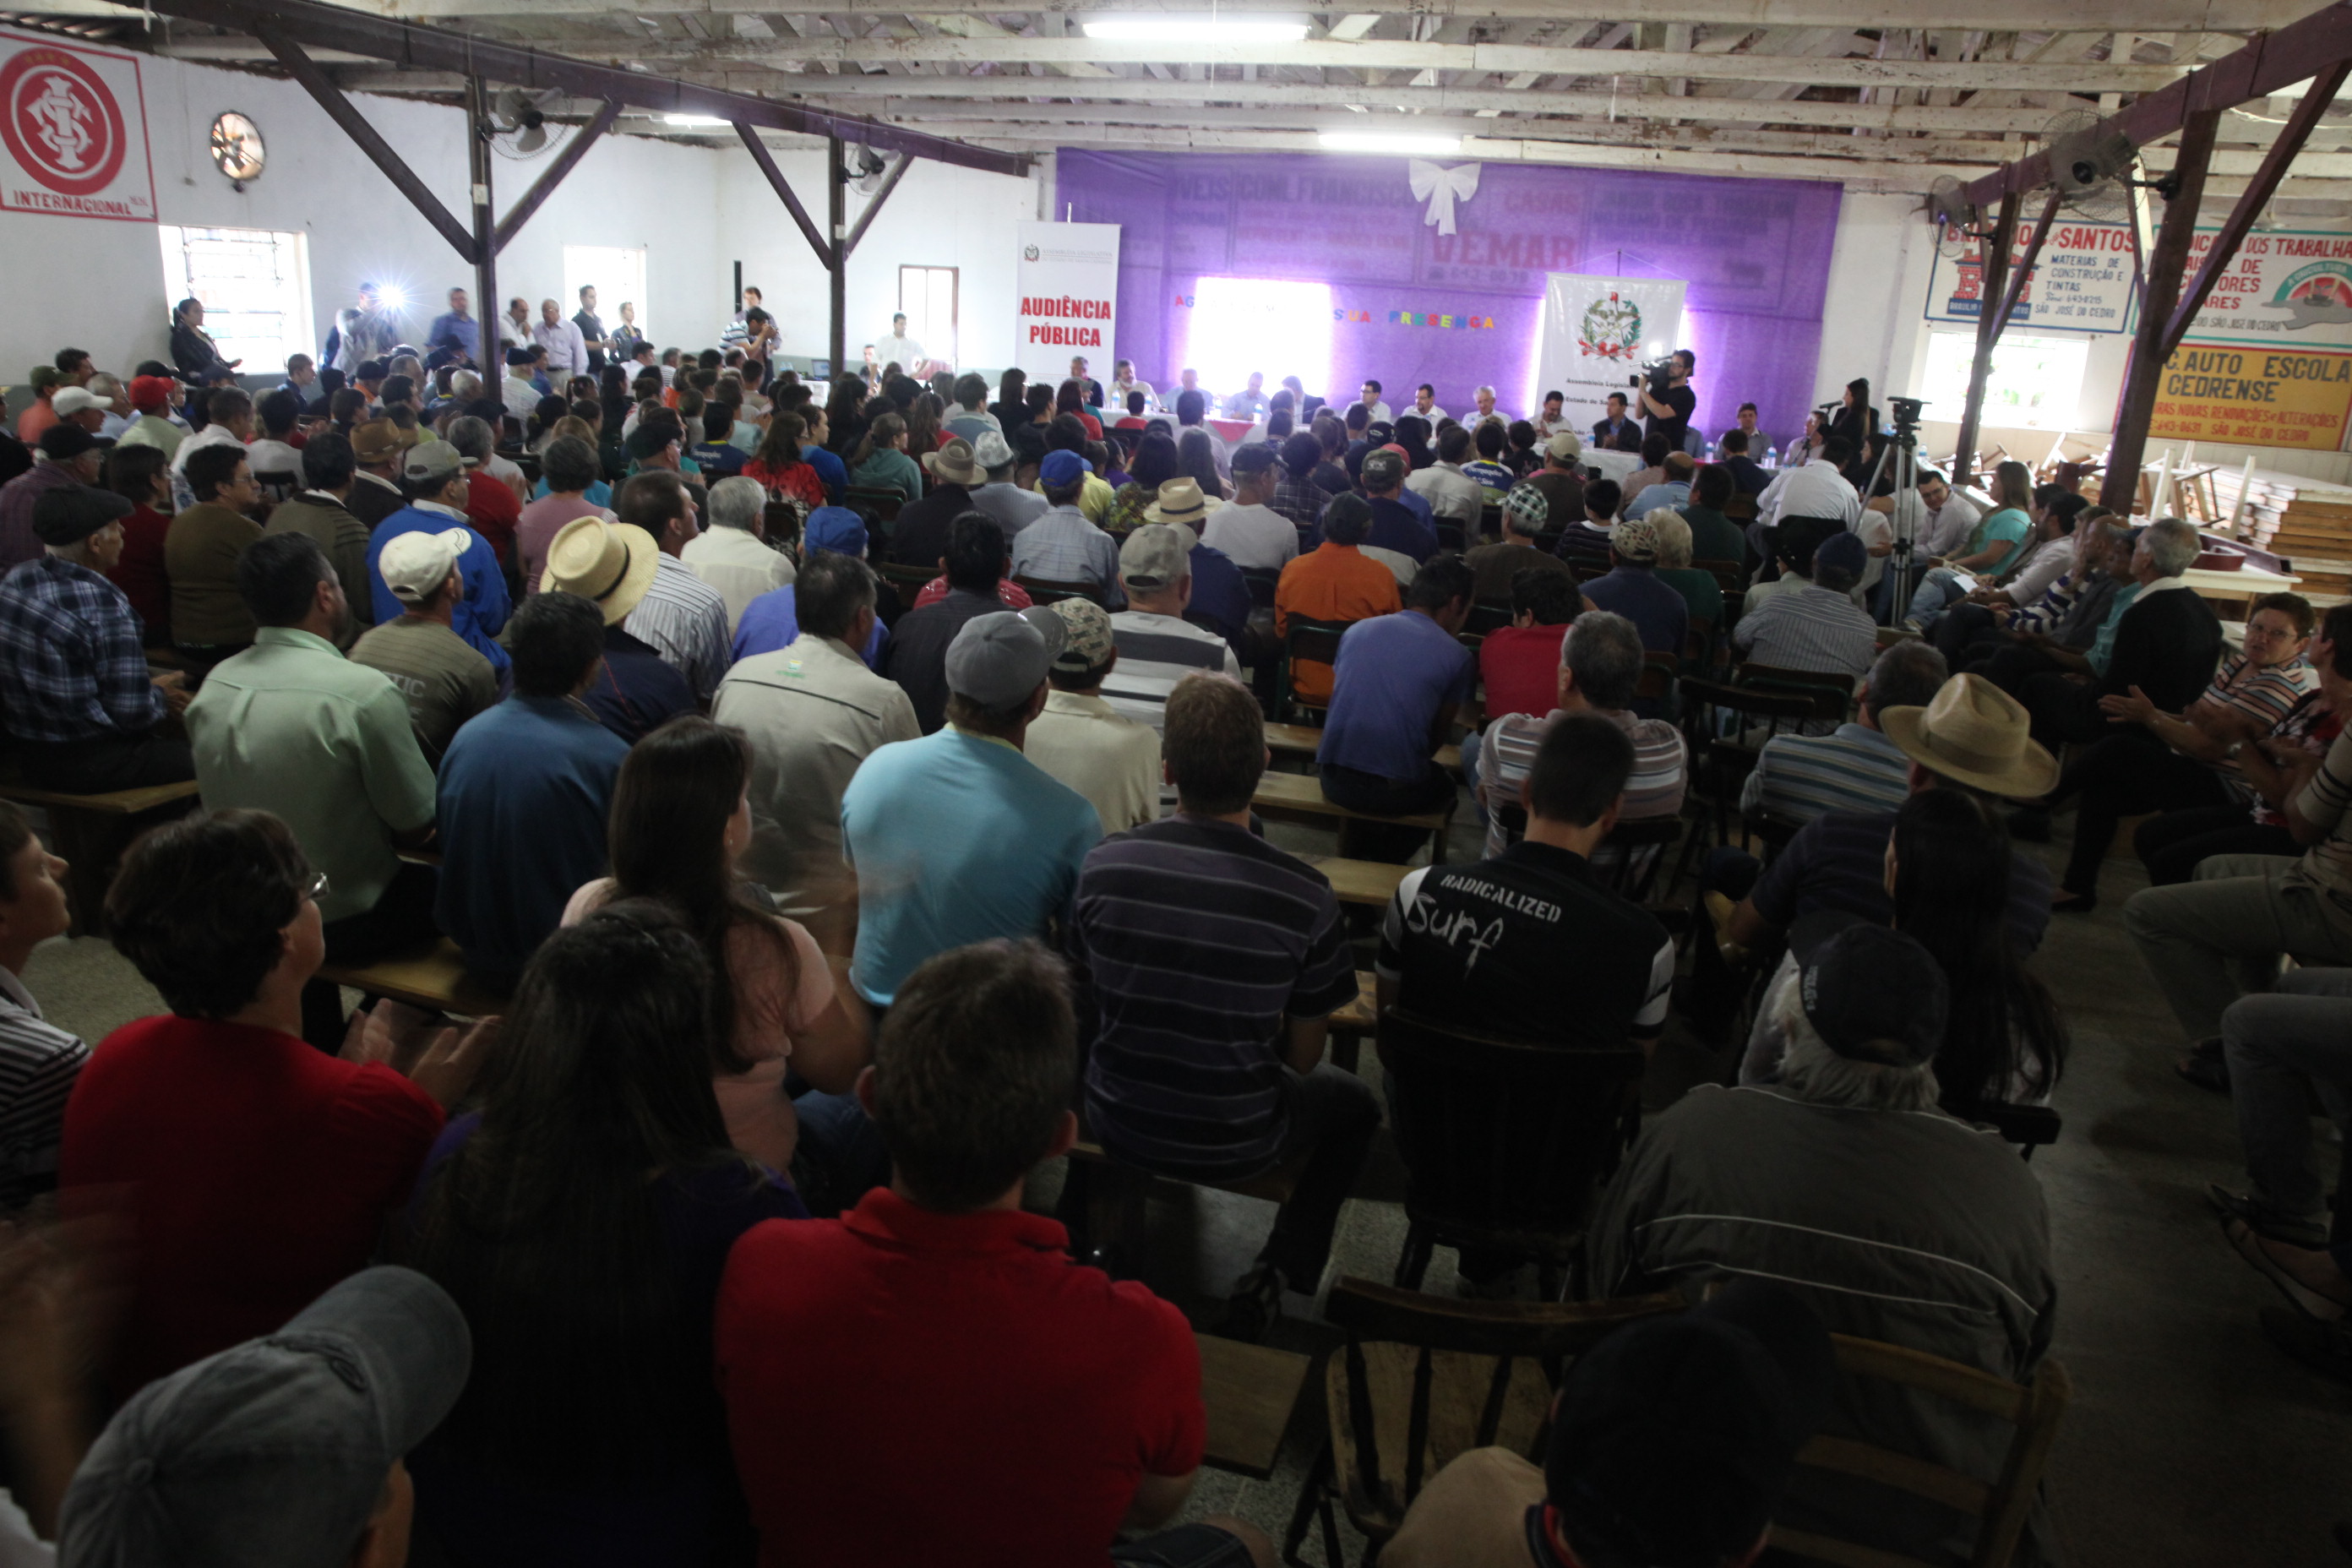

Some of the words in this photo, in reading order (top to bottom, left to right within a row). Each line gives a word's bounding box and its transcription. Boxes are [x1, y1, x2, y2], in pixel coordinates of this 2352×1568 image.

[13, 190, 132, 215] INTERNACIONAL
[2058, 226, 2134, 253] SANTOS
[2246, 237, 2271, 255] DOS
[2107, 257, 2121, 269] DE
[2240, 258, 2263, 275] DE
[2051, 267, 2114, 281] CONSTRUÇÃO
[2116, 271, 2124, 281] E
[2045, 280, 2081, 291] TINTAS
[1021, 295, 1111, 319] AUDIÊNCIA
[1333, 308, 1371, 323] SUA
[2034, 302, 2050, 314] SÃO
[2055, 304, 2074, 316] JOSÉ
[2088, 307, 2116, 319] CEDRO
[1029, 322, 1102, 347] PÚBLICA
[2184, 351, 2244, 374] AUTO
[2262, 356, 2351, 384] ESCOLA
[2167, 374, 2280, 403] CEDRENSE
[2177, 403, 2209, 418] NOVAS
[2210, 422, 2230, 436] SÃO
[2232, 424, 2257, 438] JOSÉ
[1440, 874, 1562, 923] RADICALIZED
[1407, 891, 1504, 983] Surf
